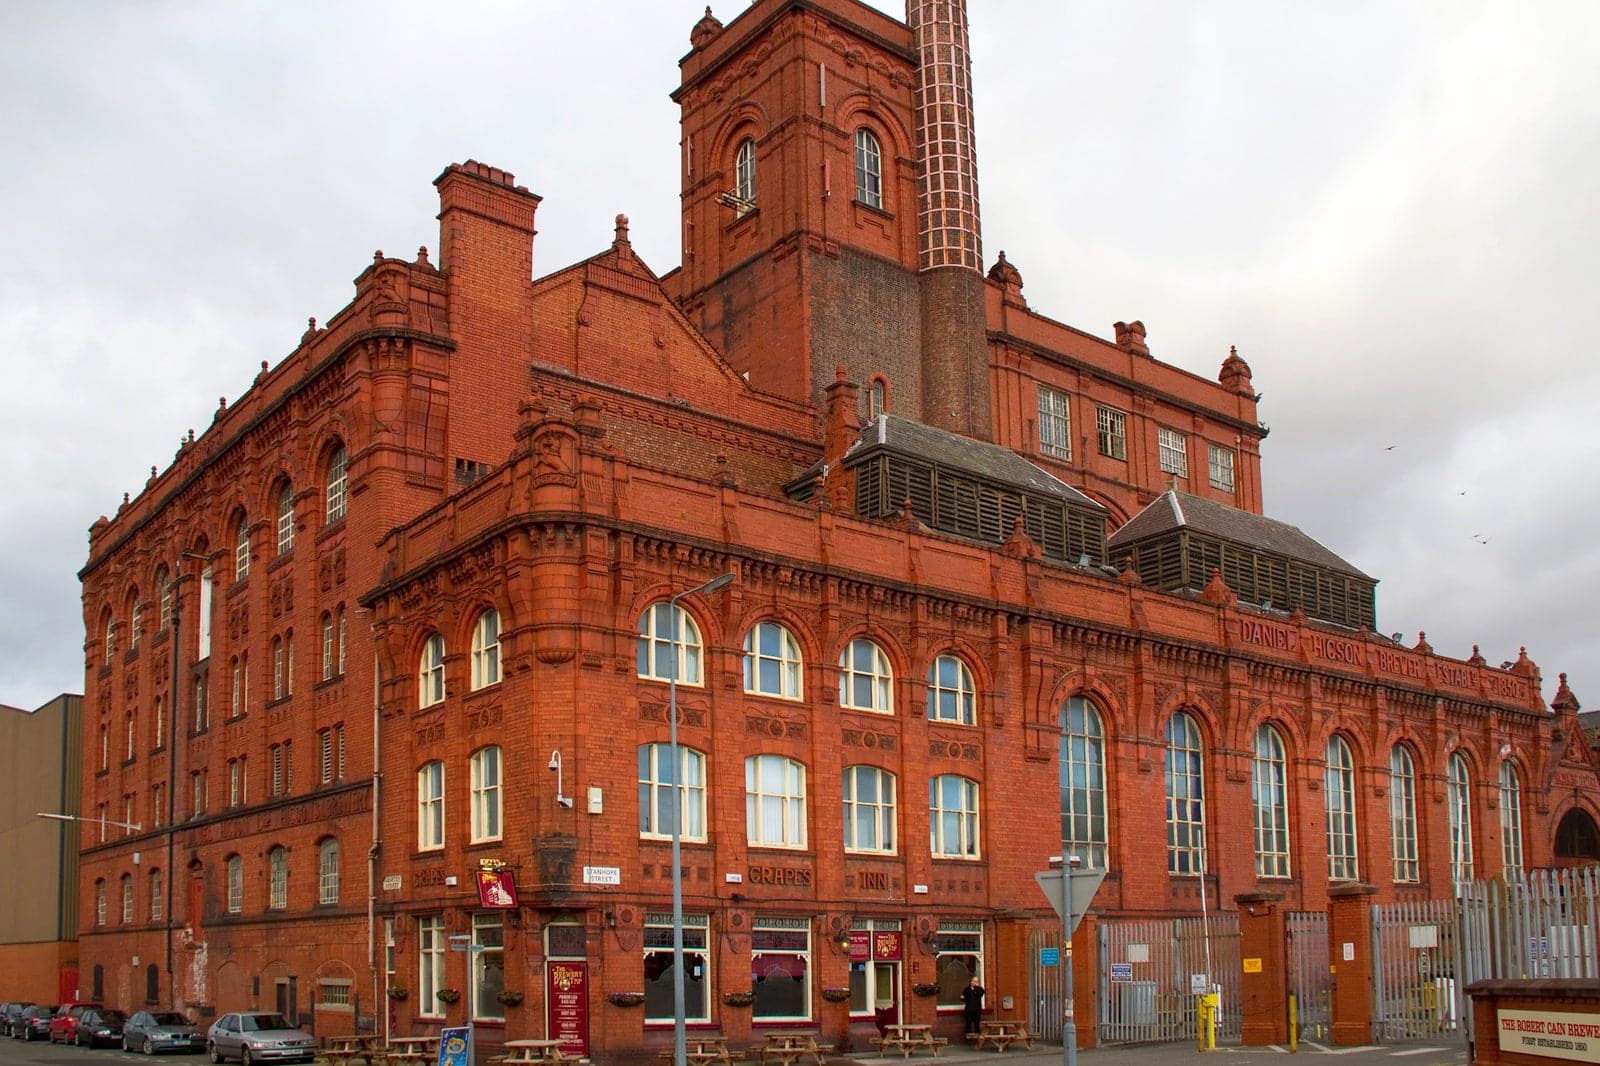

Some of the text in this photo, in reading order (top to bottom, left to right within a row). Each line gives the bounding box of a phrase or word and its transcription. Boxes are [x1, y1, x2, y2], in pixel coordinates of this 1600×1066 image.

[1241, 620, 1297, 650] DANIEL
[1379, 652, 1421, 679] BREWER
[586, 868, 617, 877] STANHOPE
[749, 866, 889, 889] GRAPES INN
[553, 971, 583, 983] BREWERY
[1501, 1018, 1600, 1039] THE ROBERT CAIN BREWE
[1521, 1036, 1536, 1046] FIRST
[1537, 1038, 1573, 1050] ESTABLISHED
